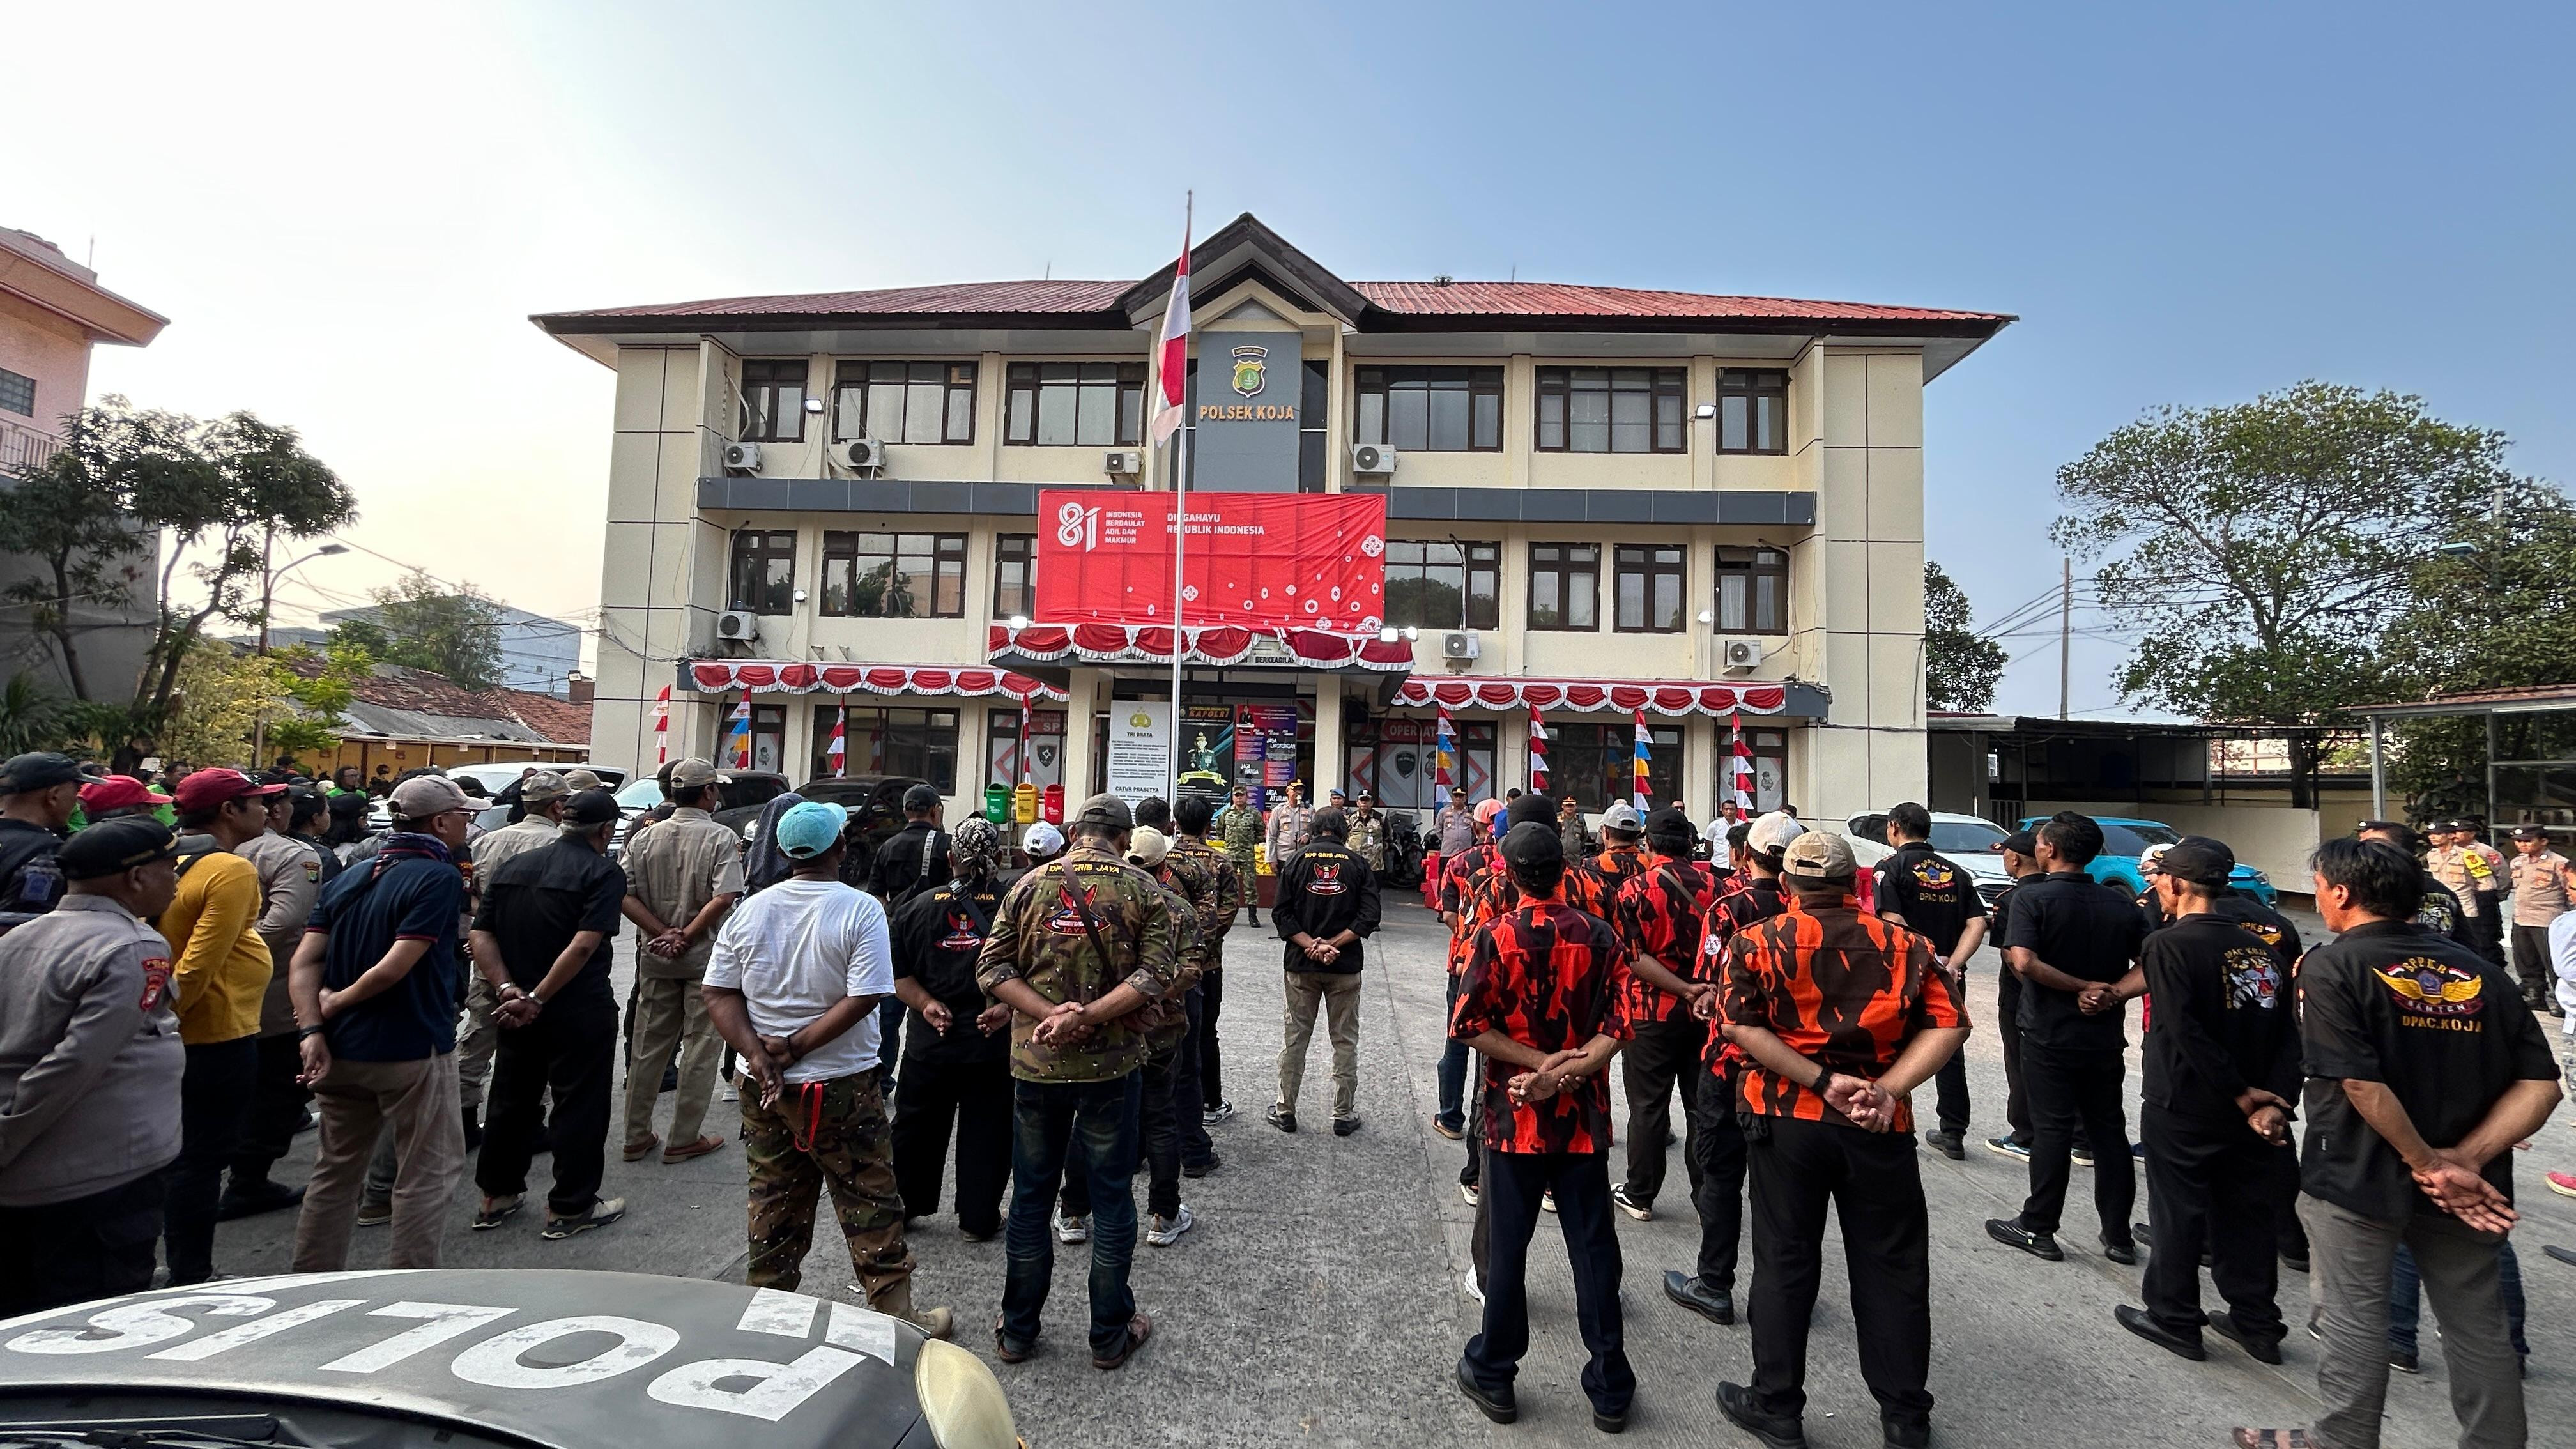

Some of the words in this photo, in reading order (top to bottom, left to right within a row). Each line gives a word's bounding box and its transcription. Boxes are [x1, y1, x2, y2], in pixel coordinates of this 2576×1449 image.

[1200, 405, 1254, 420] POLSEK
[1257, 405, 1294, 420] KOJA
[1167, 513, 1220, 523] DIGAHAYU
[1057, 502, 1102, 553] 81
[1167, 525, 1212, 534] REUBLIK
[1214, 526, 1265, 535] INDONESIA
[1390, 724, 1438, 737] OPERAT
[1096, 864, 1120, 873] JAYA
[1919, 893, 1937, 901] DPAC
[2407, 1000, 2465, 1013] BANTEN
